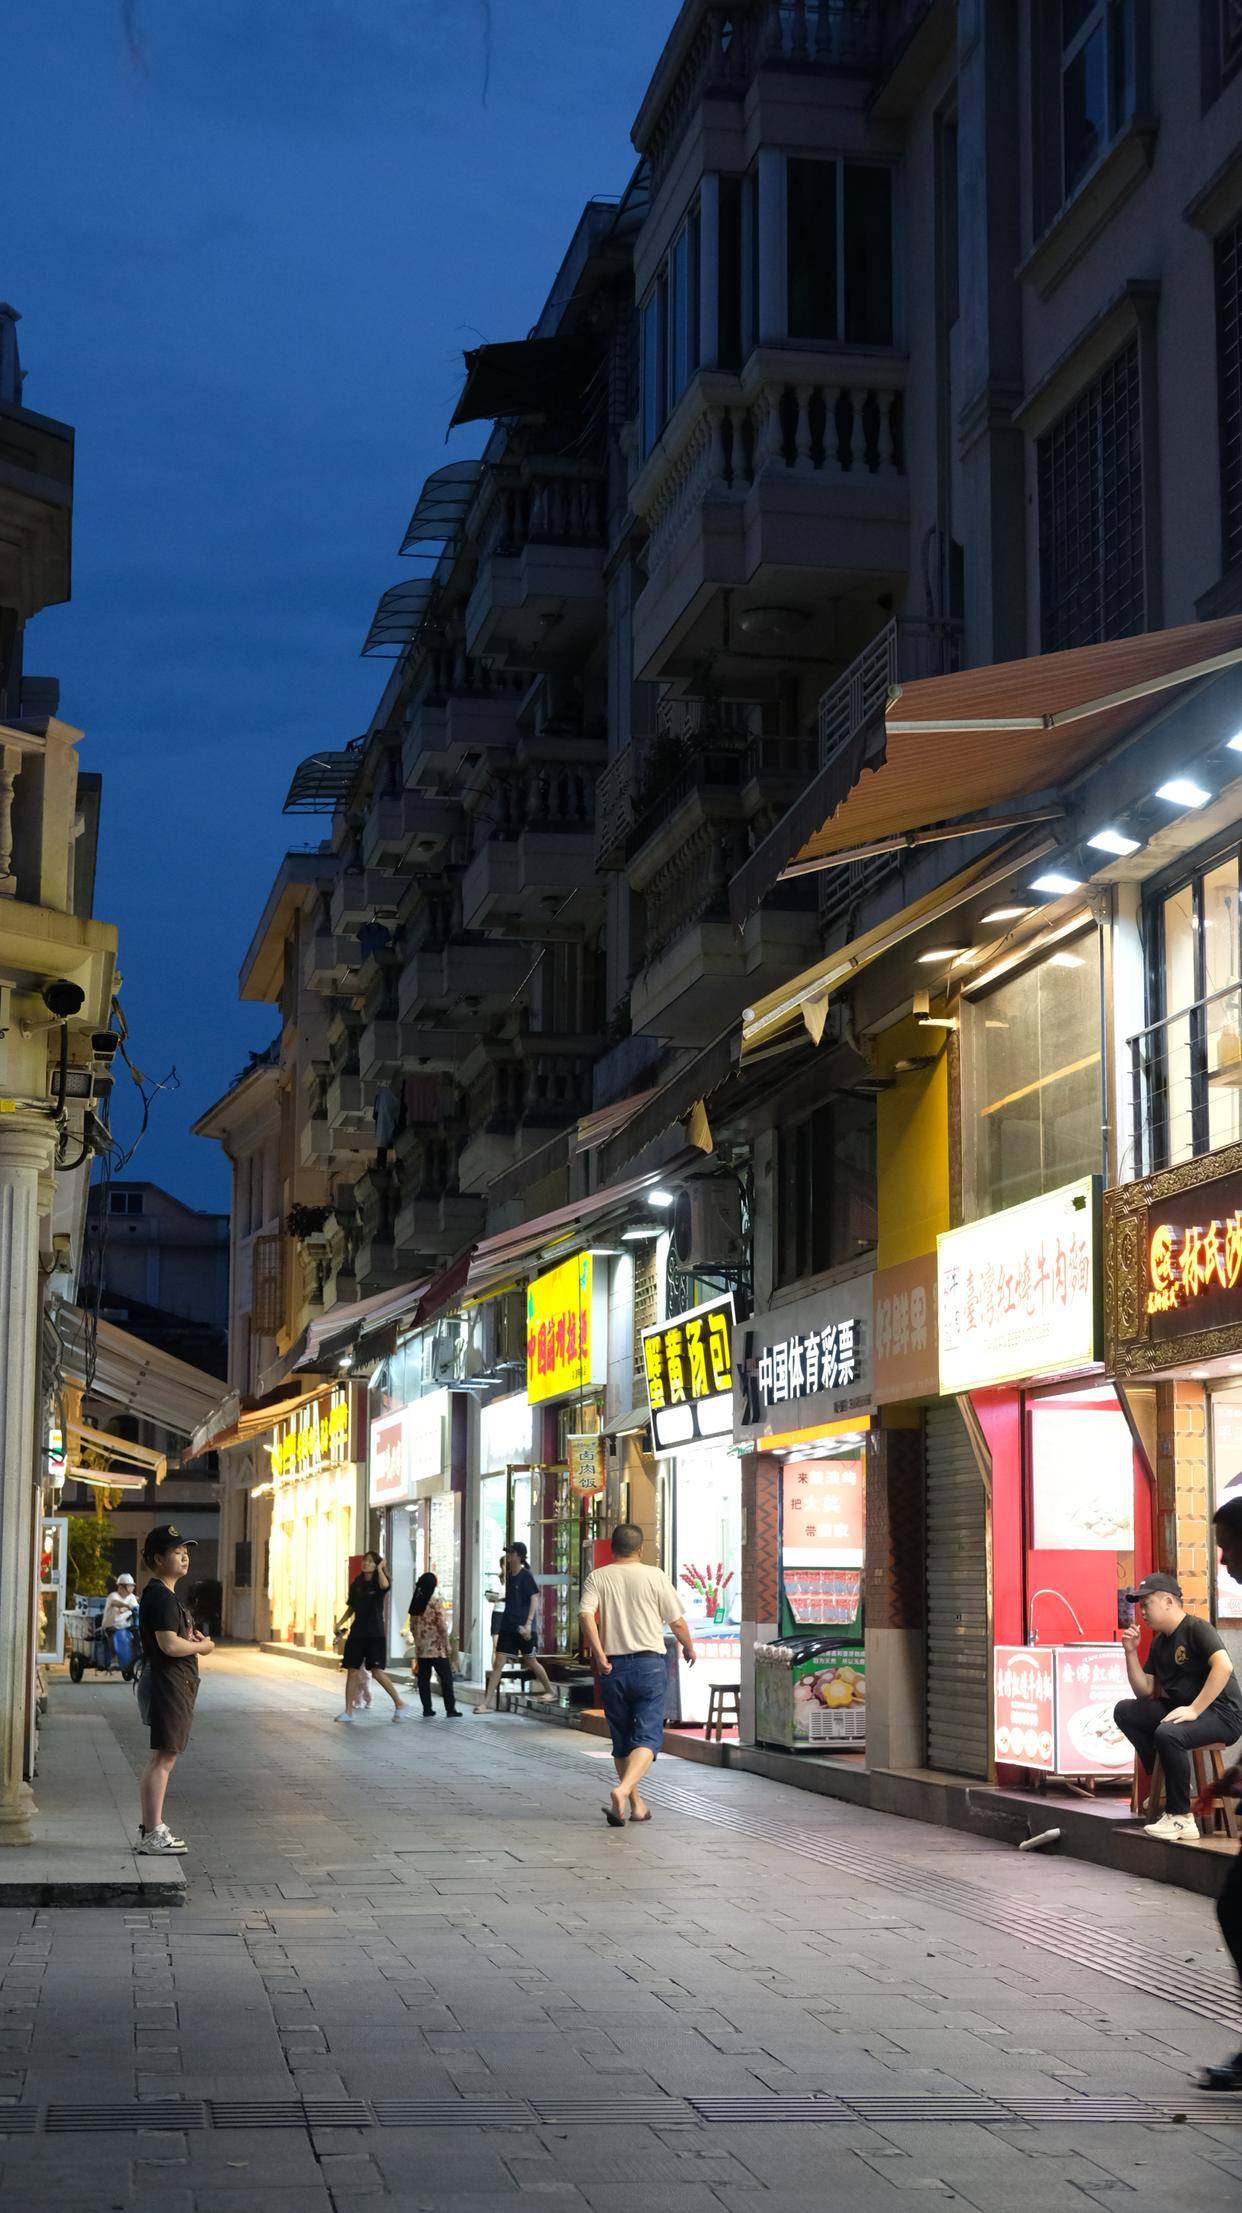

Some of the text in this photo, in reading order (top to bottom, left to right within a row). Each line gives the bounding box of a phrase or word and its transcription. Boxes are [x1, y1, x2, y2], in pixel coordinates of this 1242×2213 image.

[758, 1318, 855, 1406] 中国体育彩票
[578, 1450, 597, 1488] 卤肉饭
